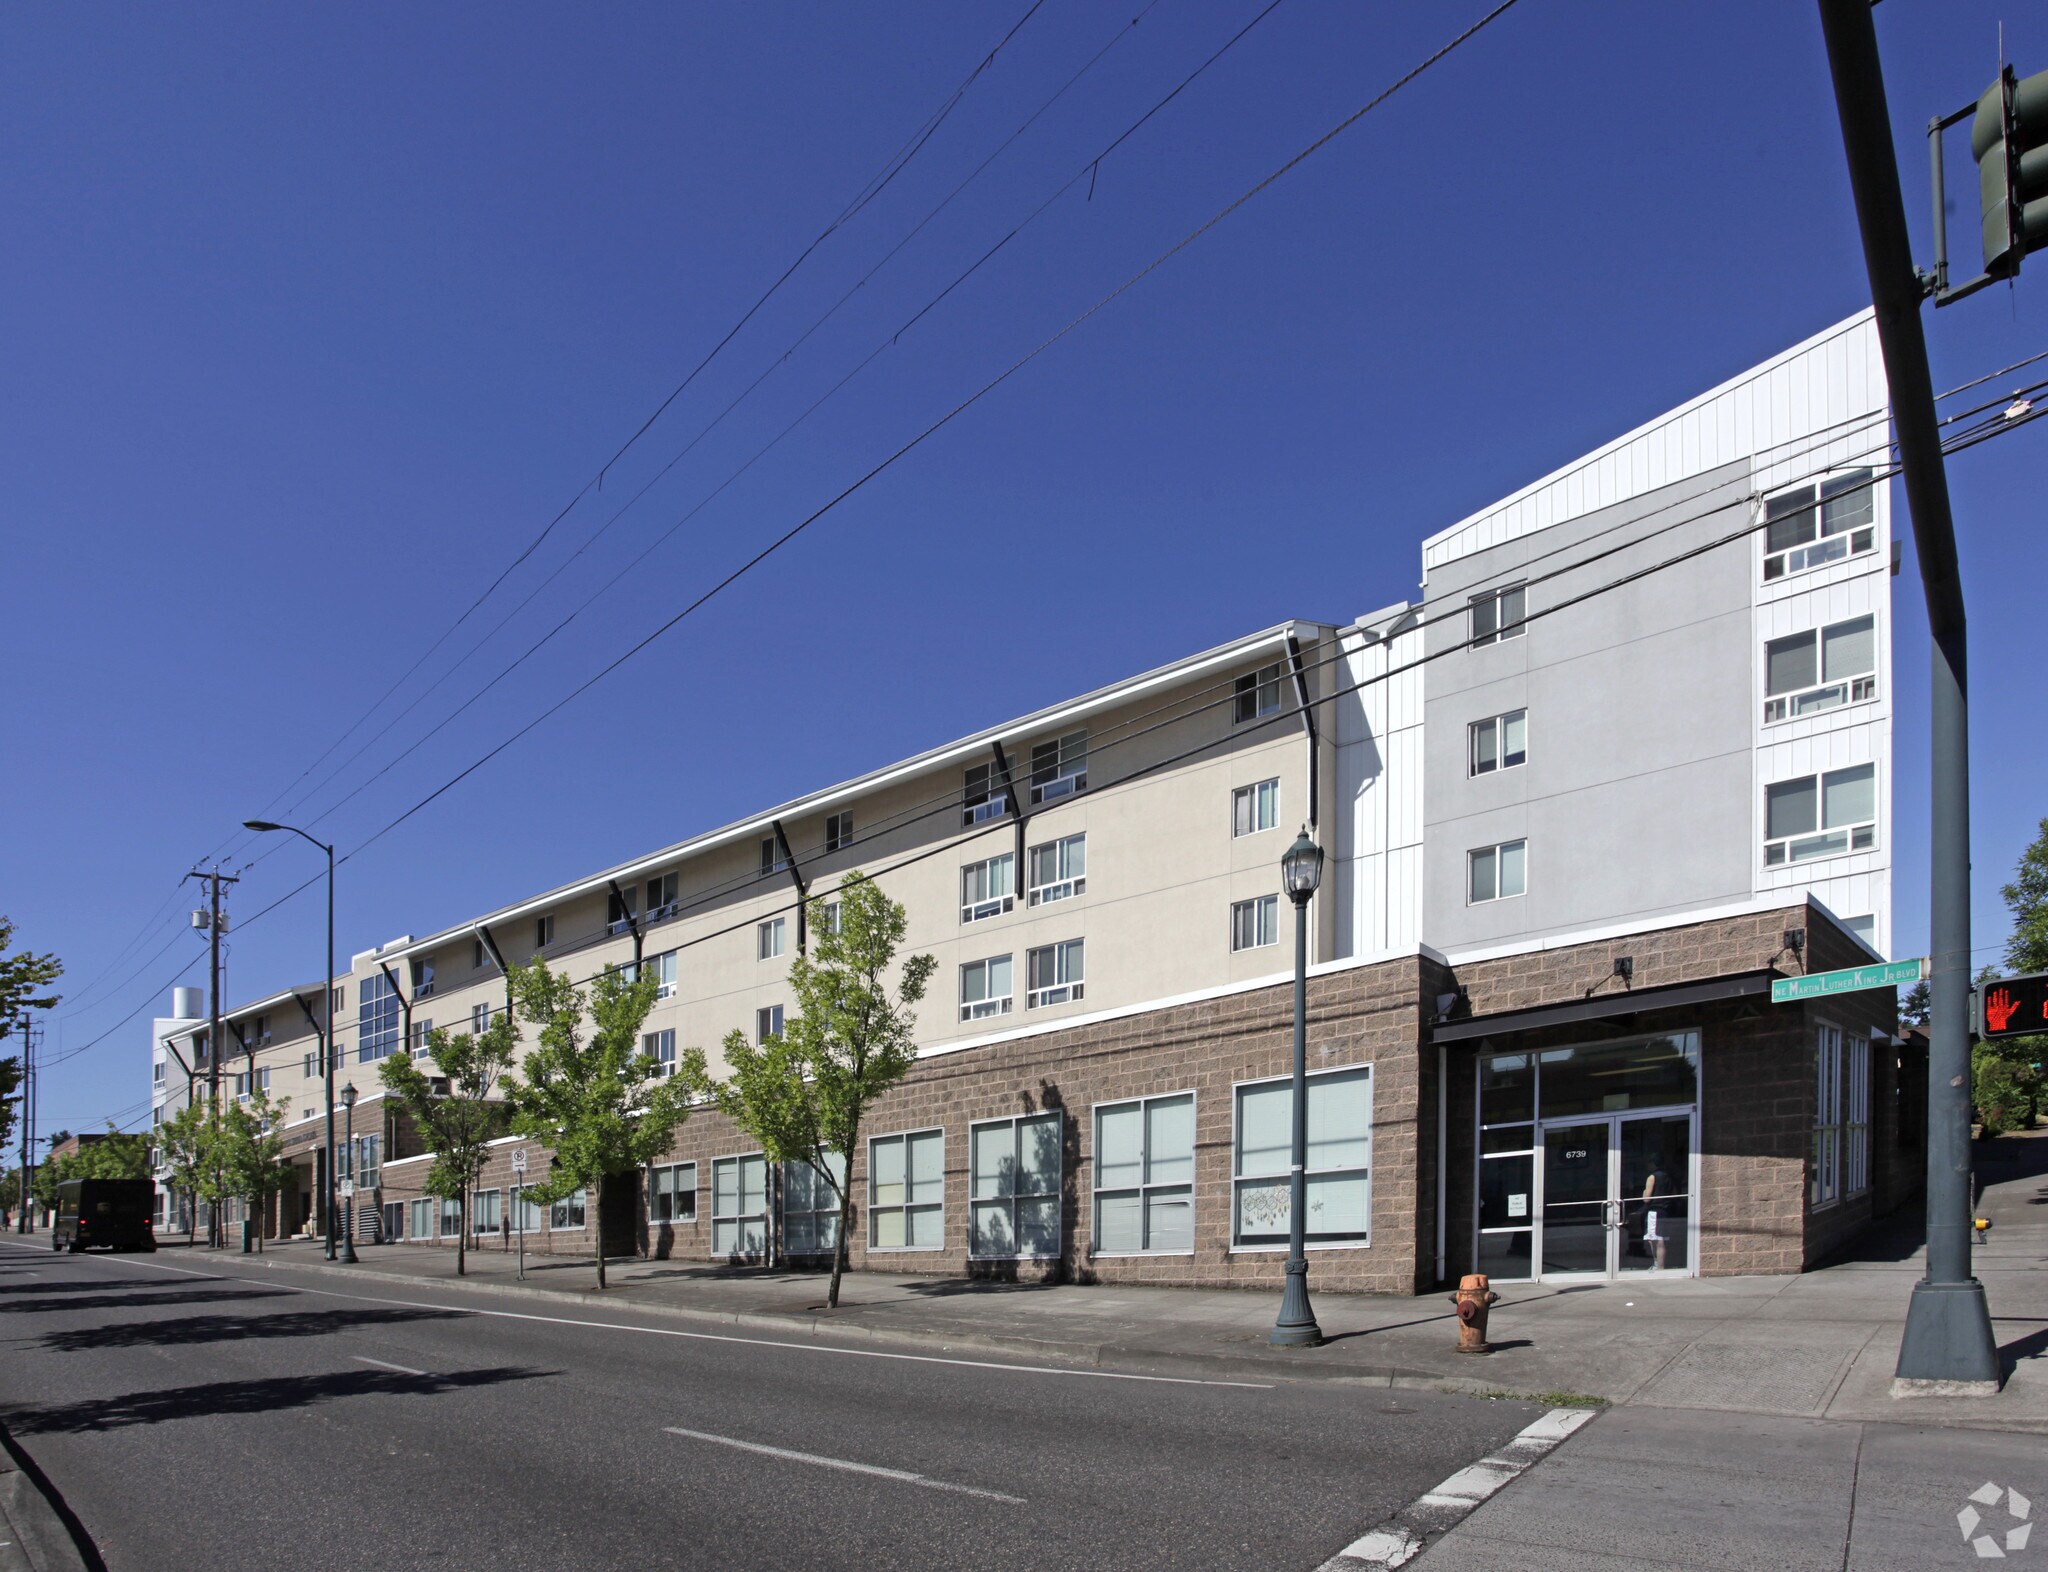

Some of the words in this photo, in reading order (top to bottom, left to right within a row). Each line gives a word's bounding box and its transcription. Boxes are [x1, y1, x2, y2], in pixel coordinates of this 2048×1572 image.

[1775, 987, 1787, 997] NE
[1789, 981, 1820, 996] MARTIN
[1821, 976, 1853, 991] LUTHER
[1854, 971, 1877, 986] KING
[1880, 967, 1895, 982] JR
[1896, 969, 1916, 979] BLVD
[1565, 1150, 1587, 1159] 6739
